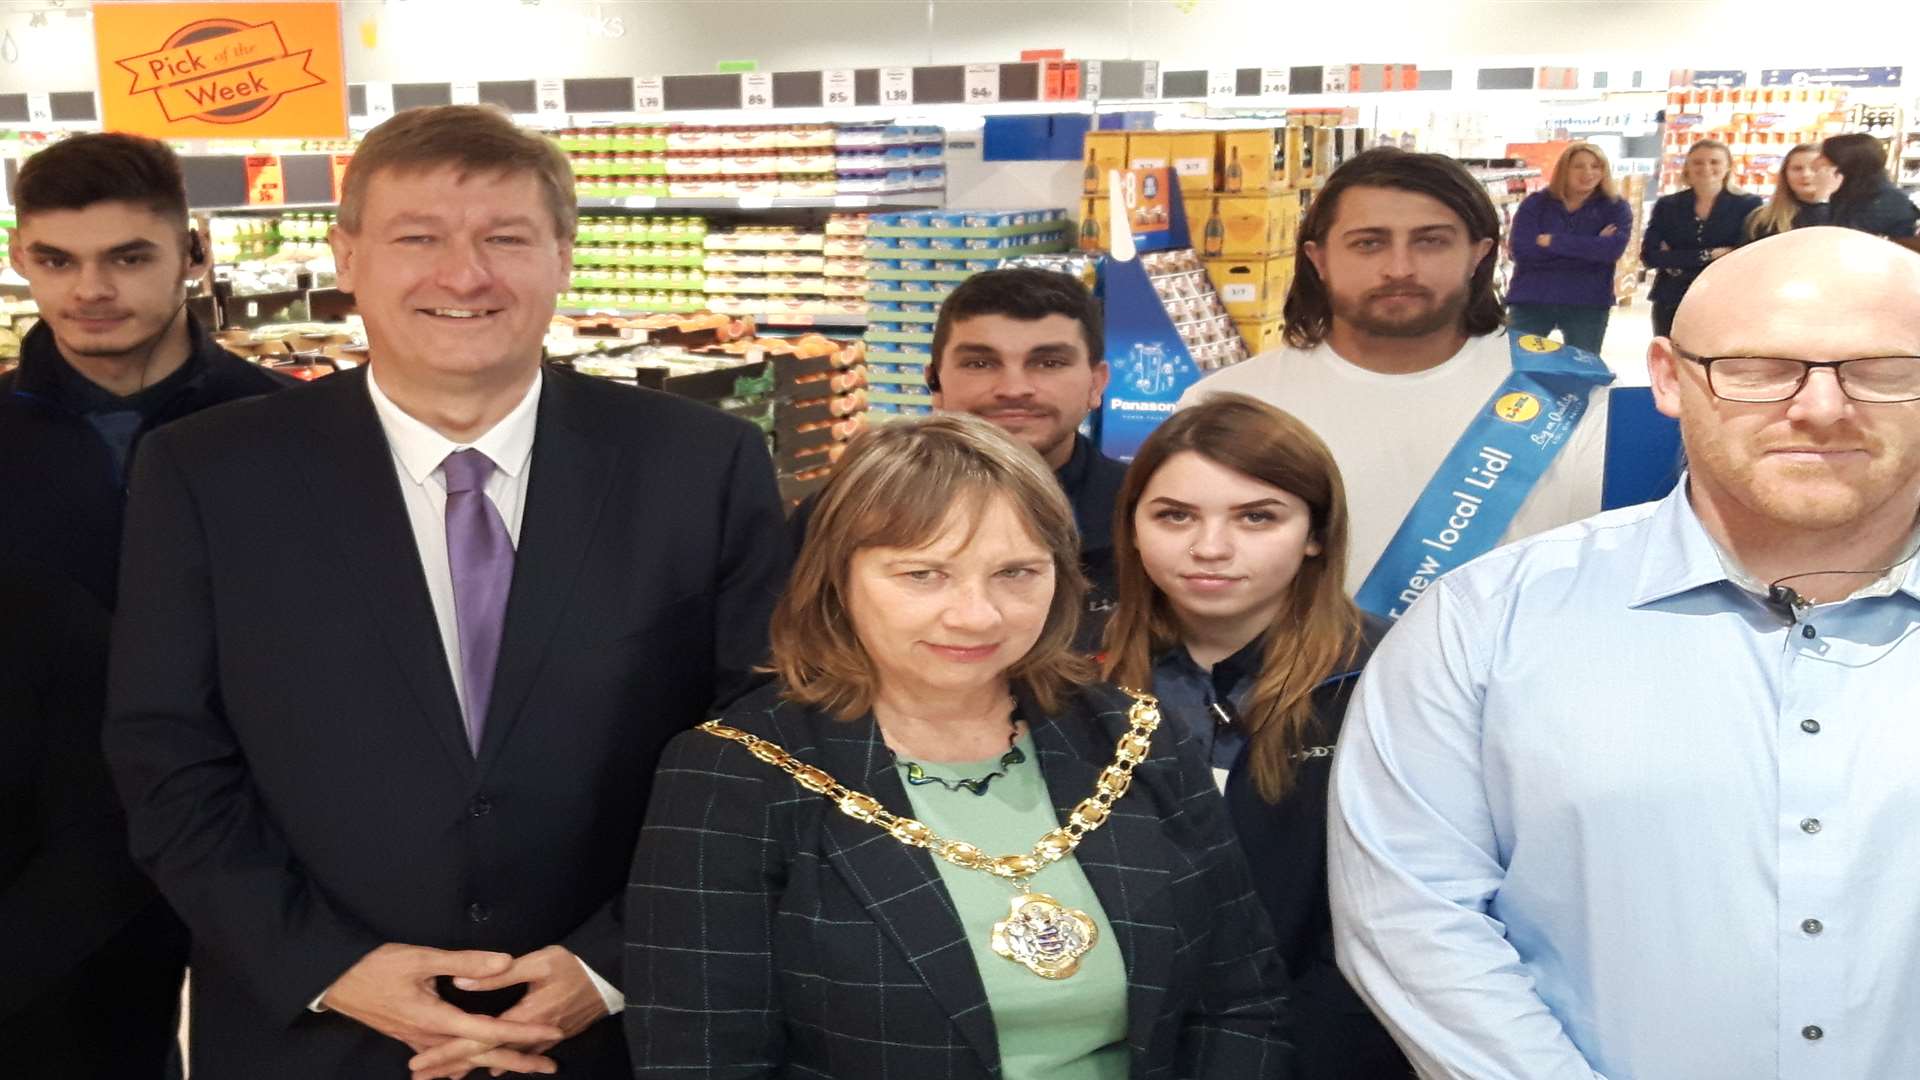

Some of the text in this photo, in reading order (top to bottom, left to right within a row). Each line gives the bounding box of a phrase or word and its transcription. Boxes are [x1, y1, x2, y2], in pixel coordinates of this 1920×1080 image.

[149, 42, 256, 80] Pick of the
[185, 71, 268, 106] Week
[1399, 446, 1513, 607] new local Lidl
